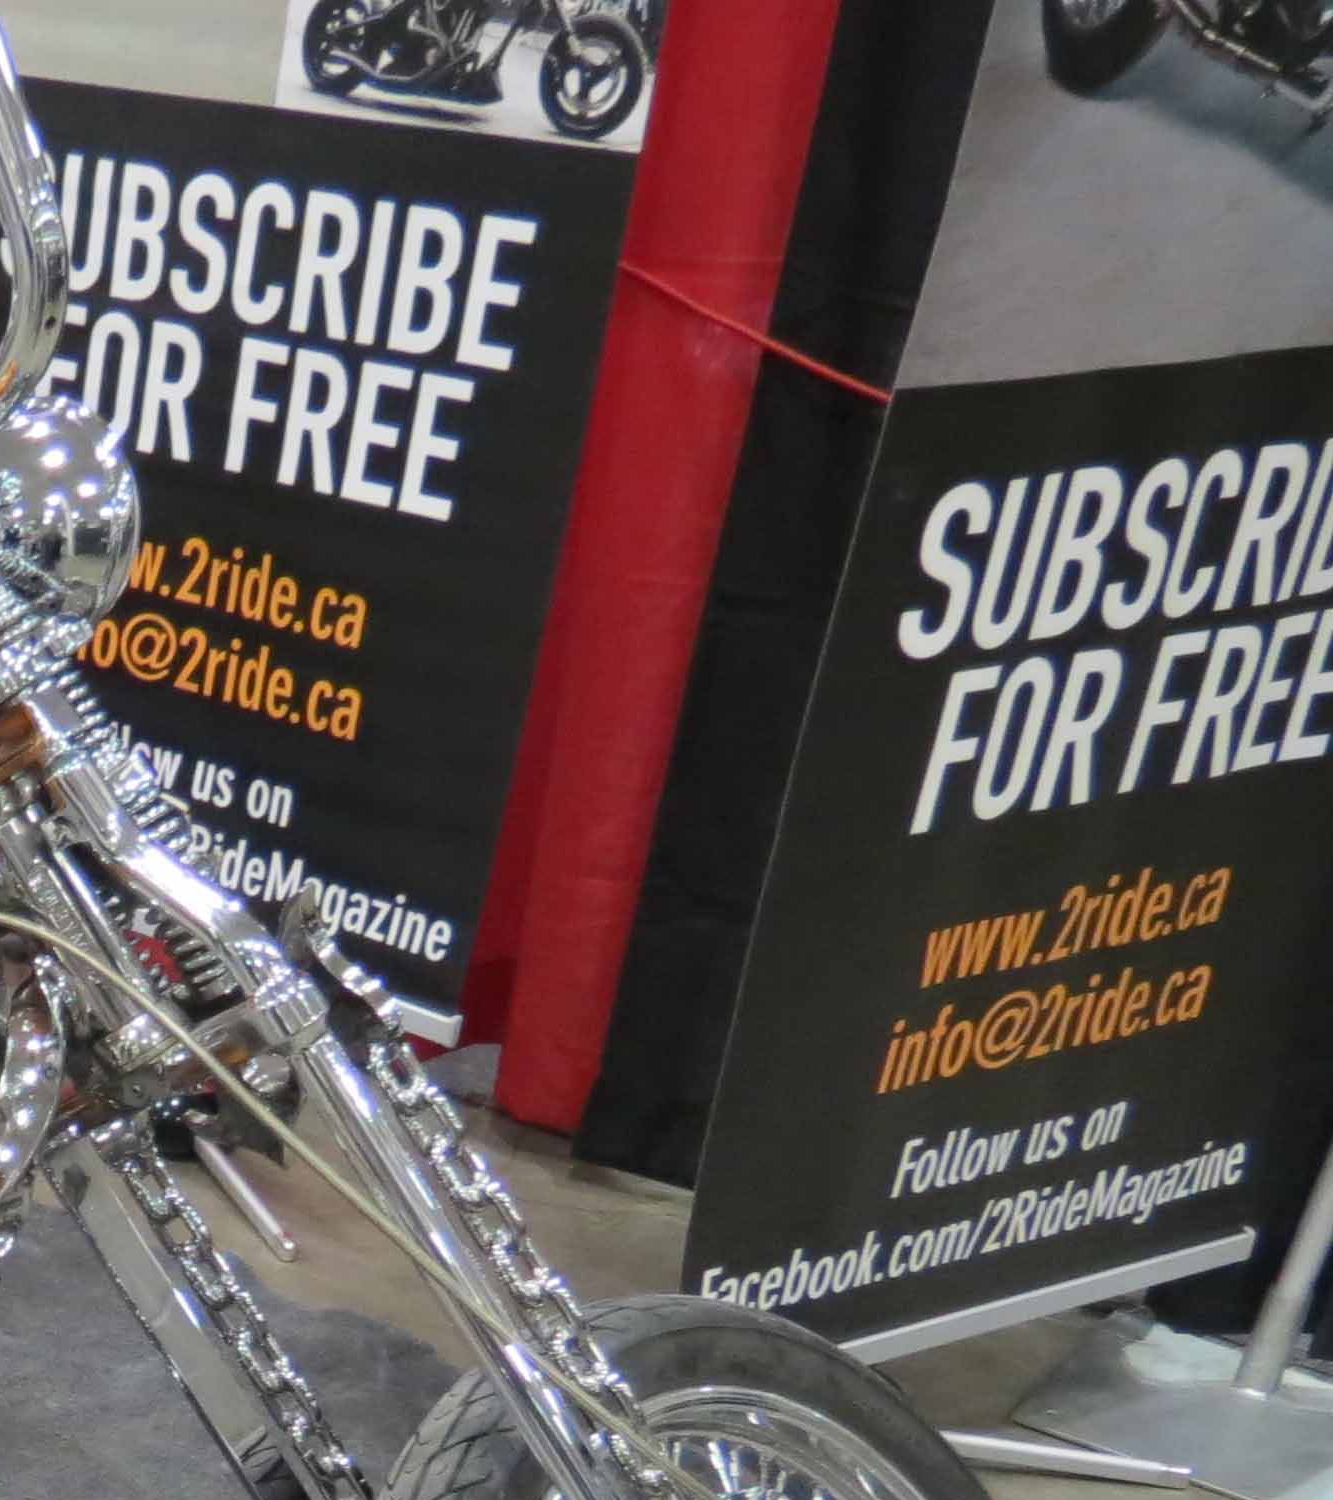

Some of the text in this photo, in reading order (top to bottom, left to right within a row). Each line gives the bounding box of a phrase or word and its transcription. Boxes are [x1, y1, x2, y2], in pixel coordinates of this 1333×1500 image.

[0, 150, 539, 373] UBSCRIBE
[223, 342, 475, 522] FREE
[191, 760, 235, 807] us
[247, 778, 293, 828] on
[910, 648, 1122, 836] FOR
[920, 866, 1233, 989] www.2ride.ca
[877, 964, 1213, 1095] info@2ride.ca
[890, 1099, 1129, 1199] Follow us on
